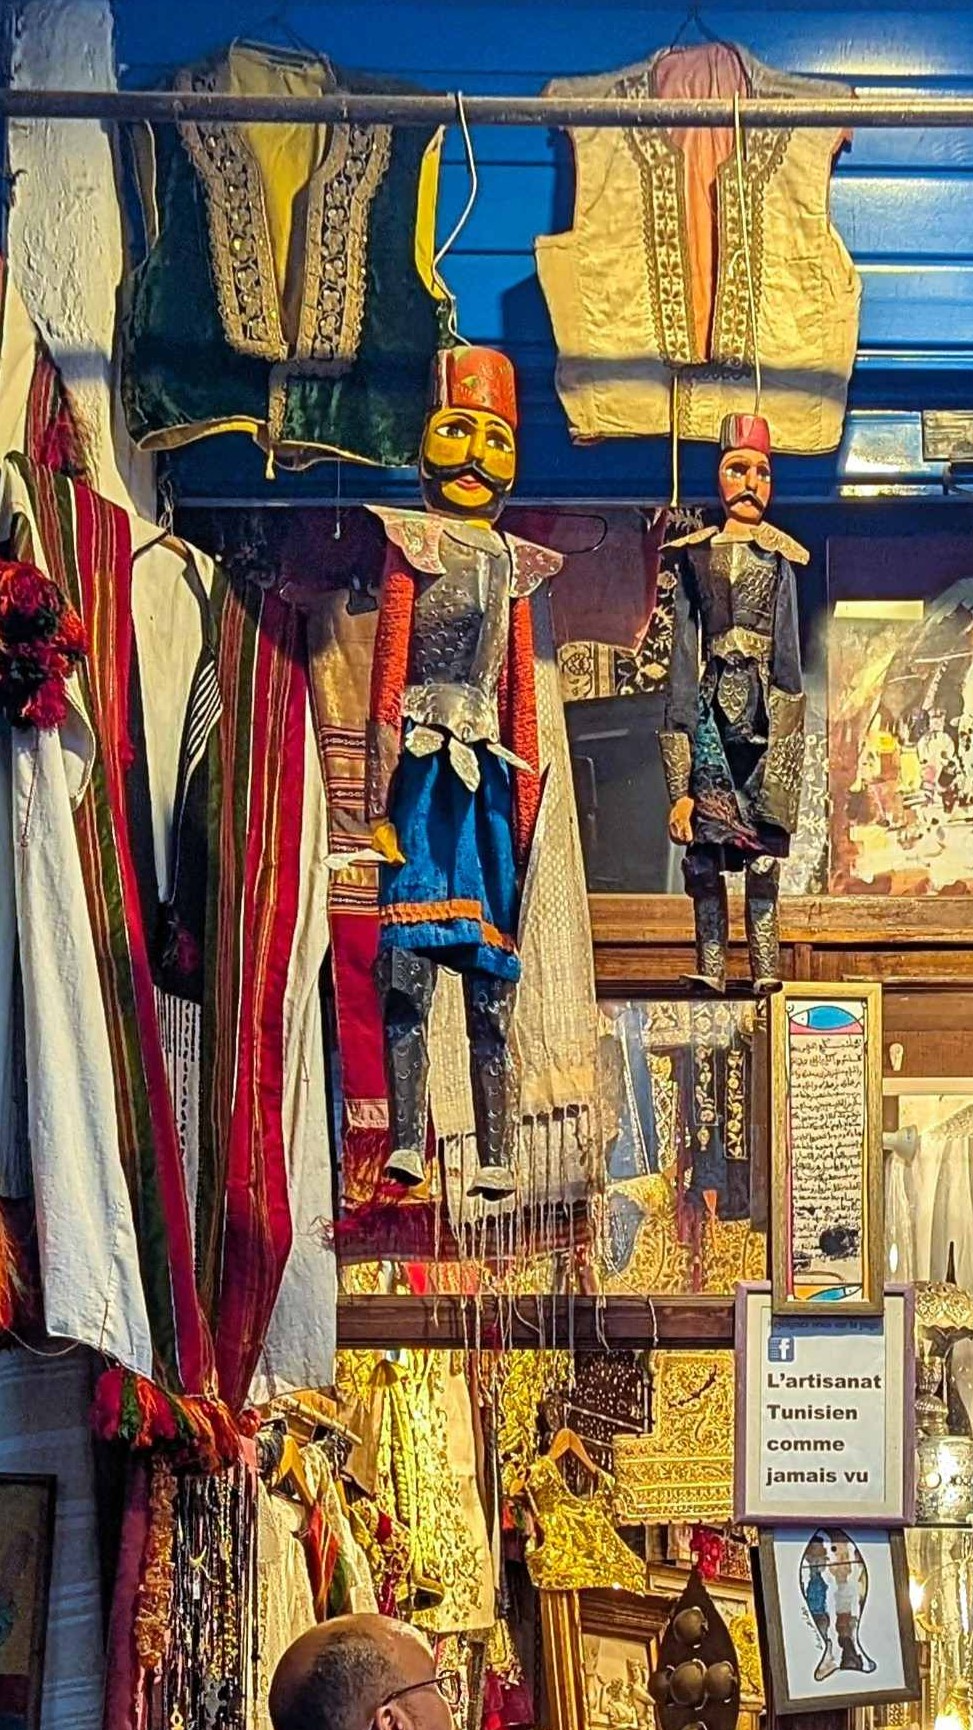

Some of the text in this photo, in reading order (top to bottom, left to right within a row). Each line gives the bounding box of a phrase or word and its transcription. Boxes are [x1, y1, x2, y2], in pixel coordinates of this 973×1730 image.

[766, 1404, 858, 1420] Tunisien
[766, 1439, 845, 1451] comme
[765, 1467, 869, 1486] jamais vu
